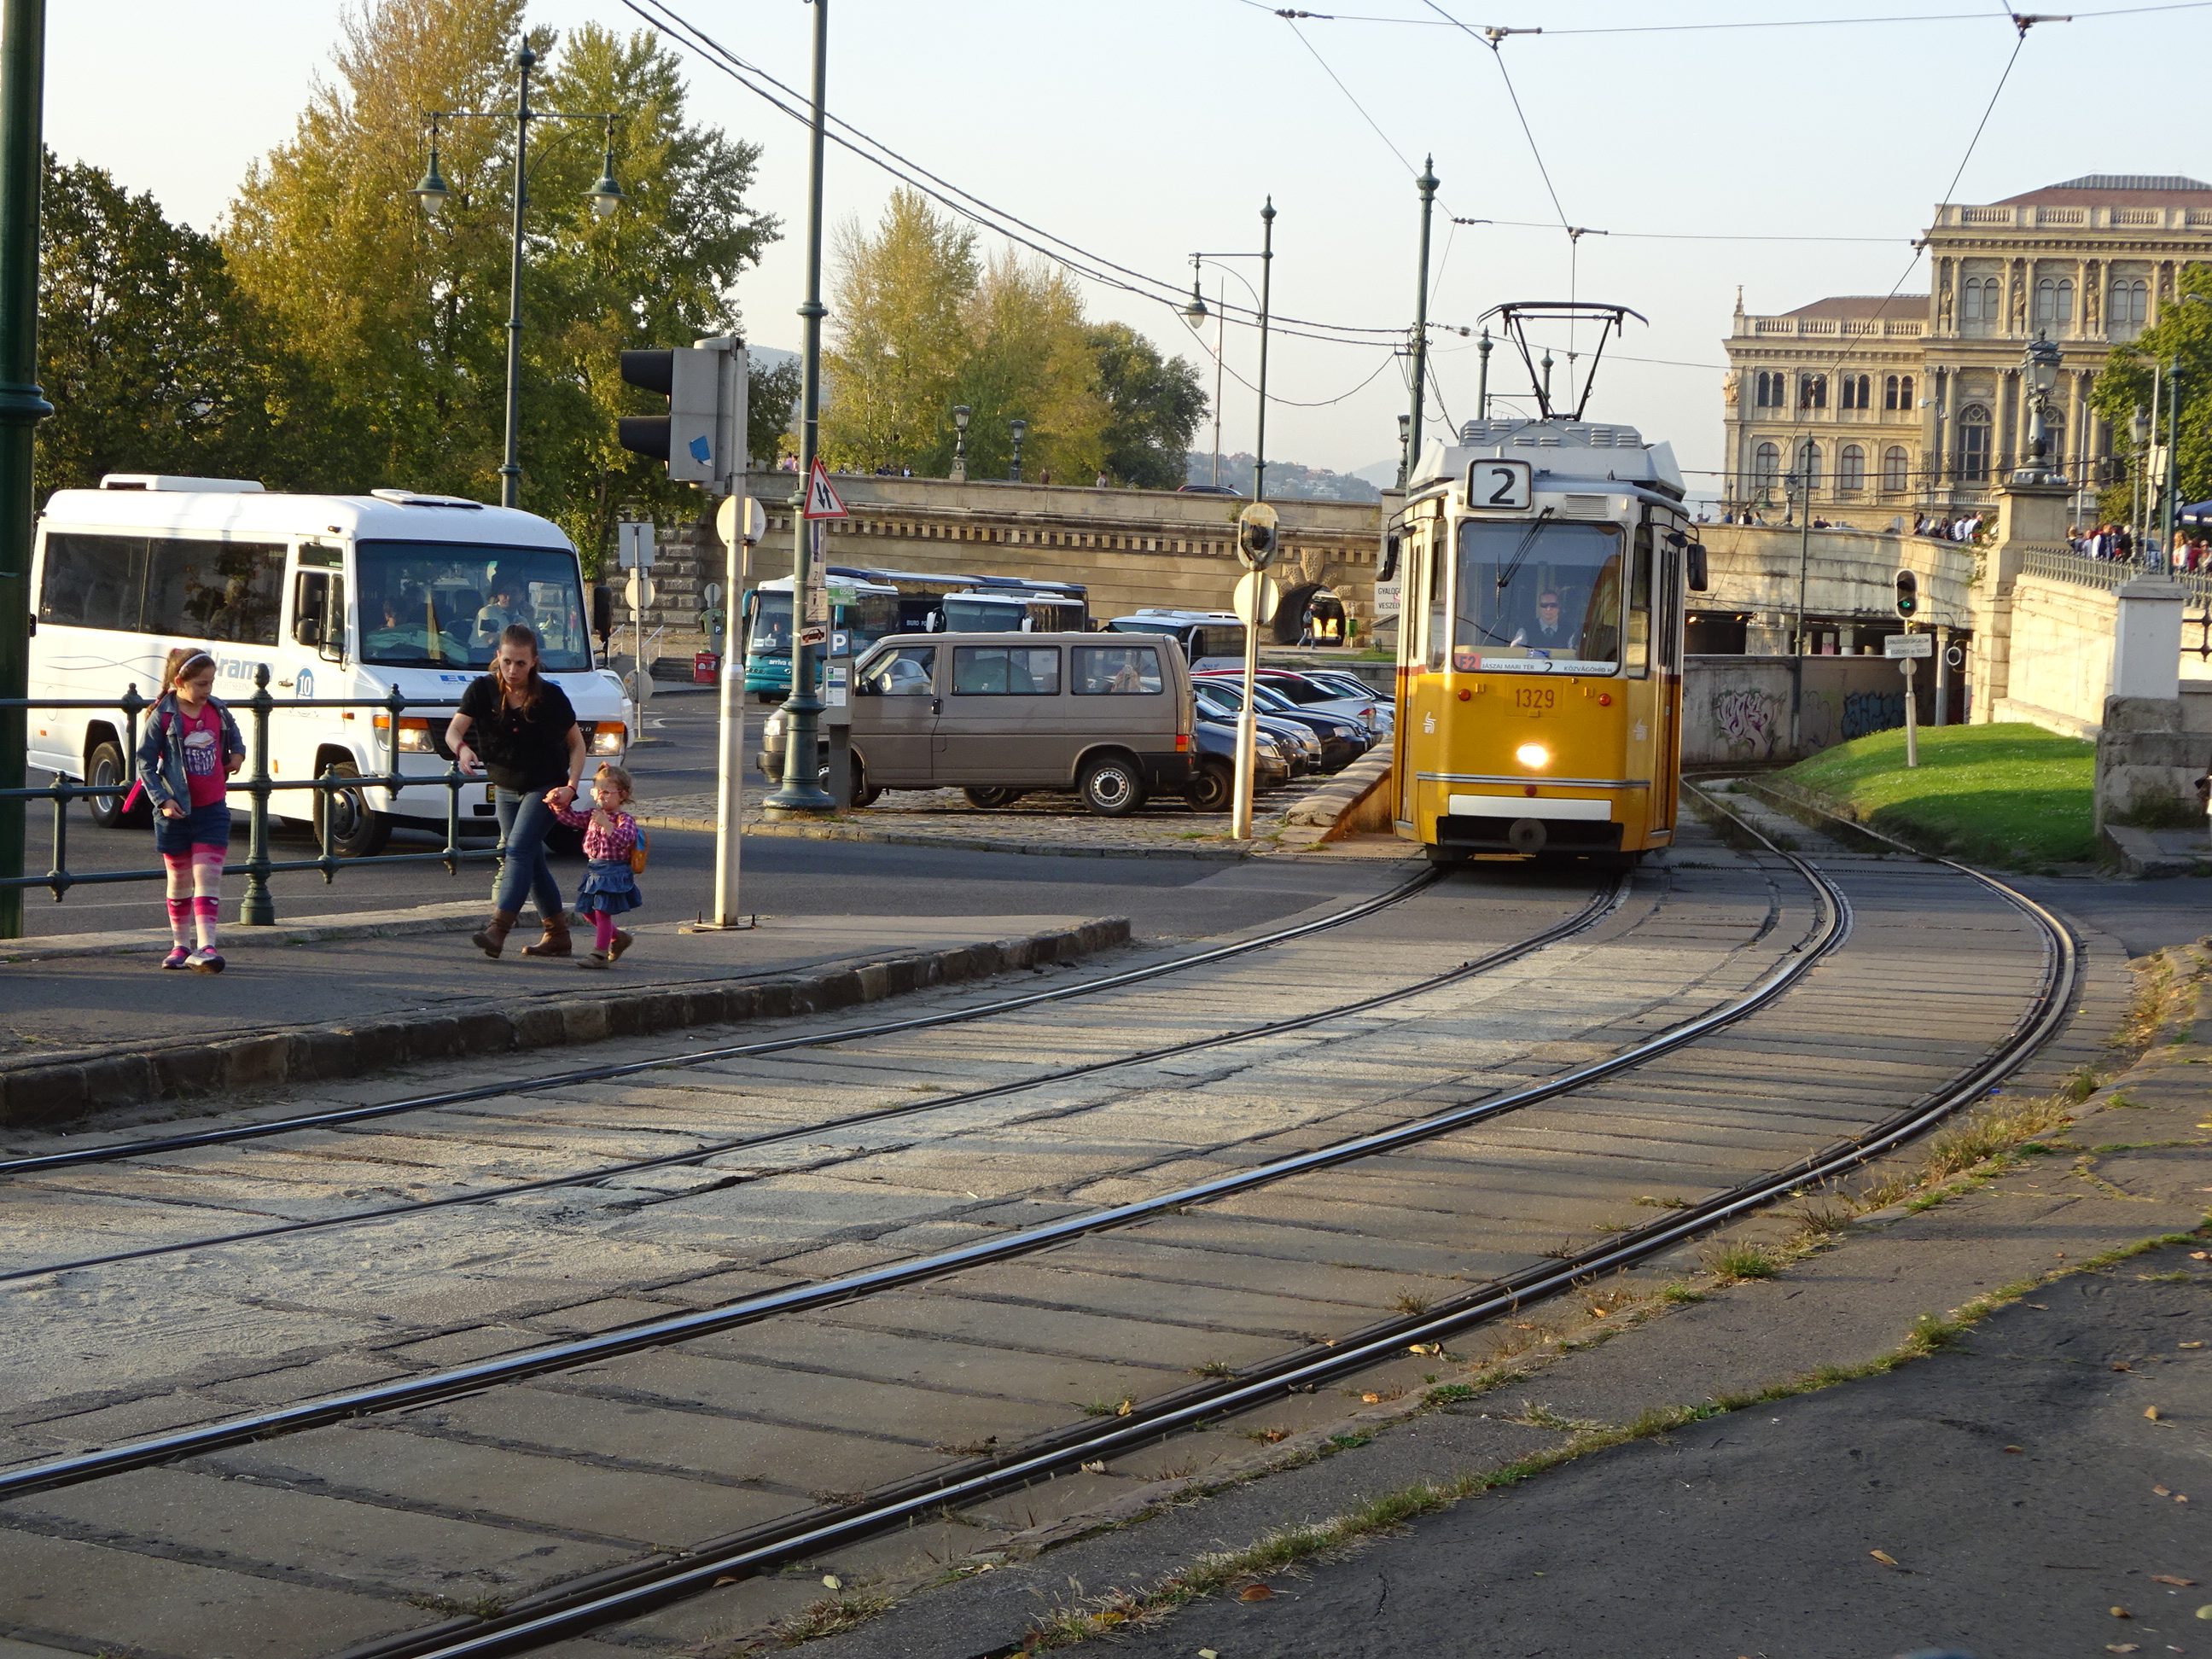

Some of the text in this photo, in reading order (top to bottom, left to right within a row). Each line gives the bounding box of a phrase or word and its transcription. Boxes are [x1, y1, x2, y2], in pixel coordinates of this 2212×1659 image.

[1489, 467, 1516, 505] 2
[832, 633, 847, 652] P
[1458, 655, 1476, 670] F2
[299, 674, 311, 696] 10
[1516, 688, 1555, 708] 1329
